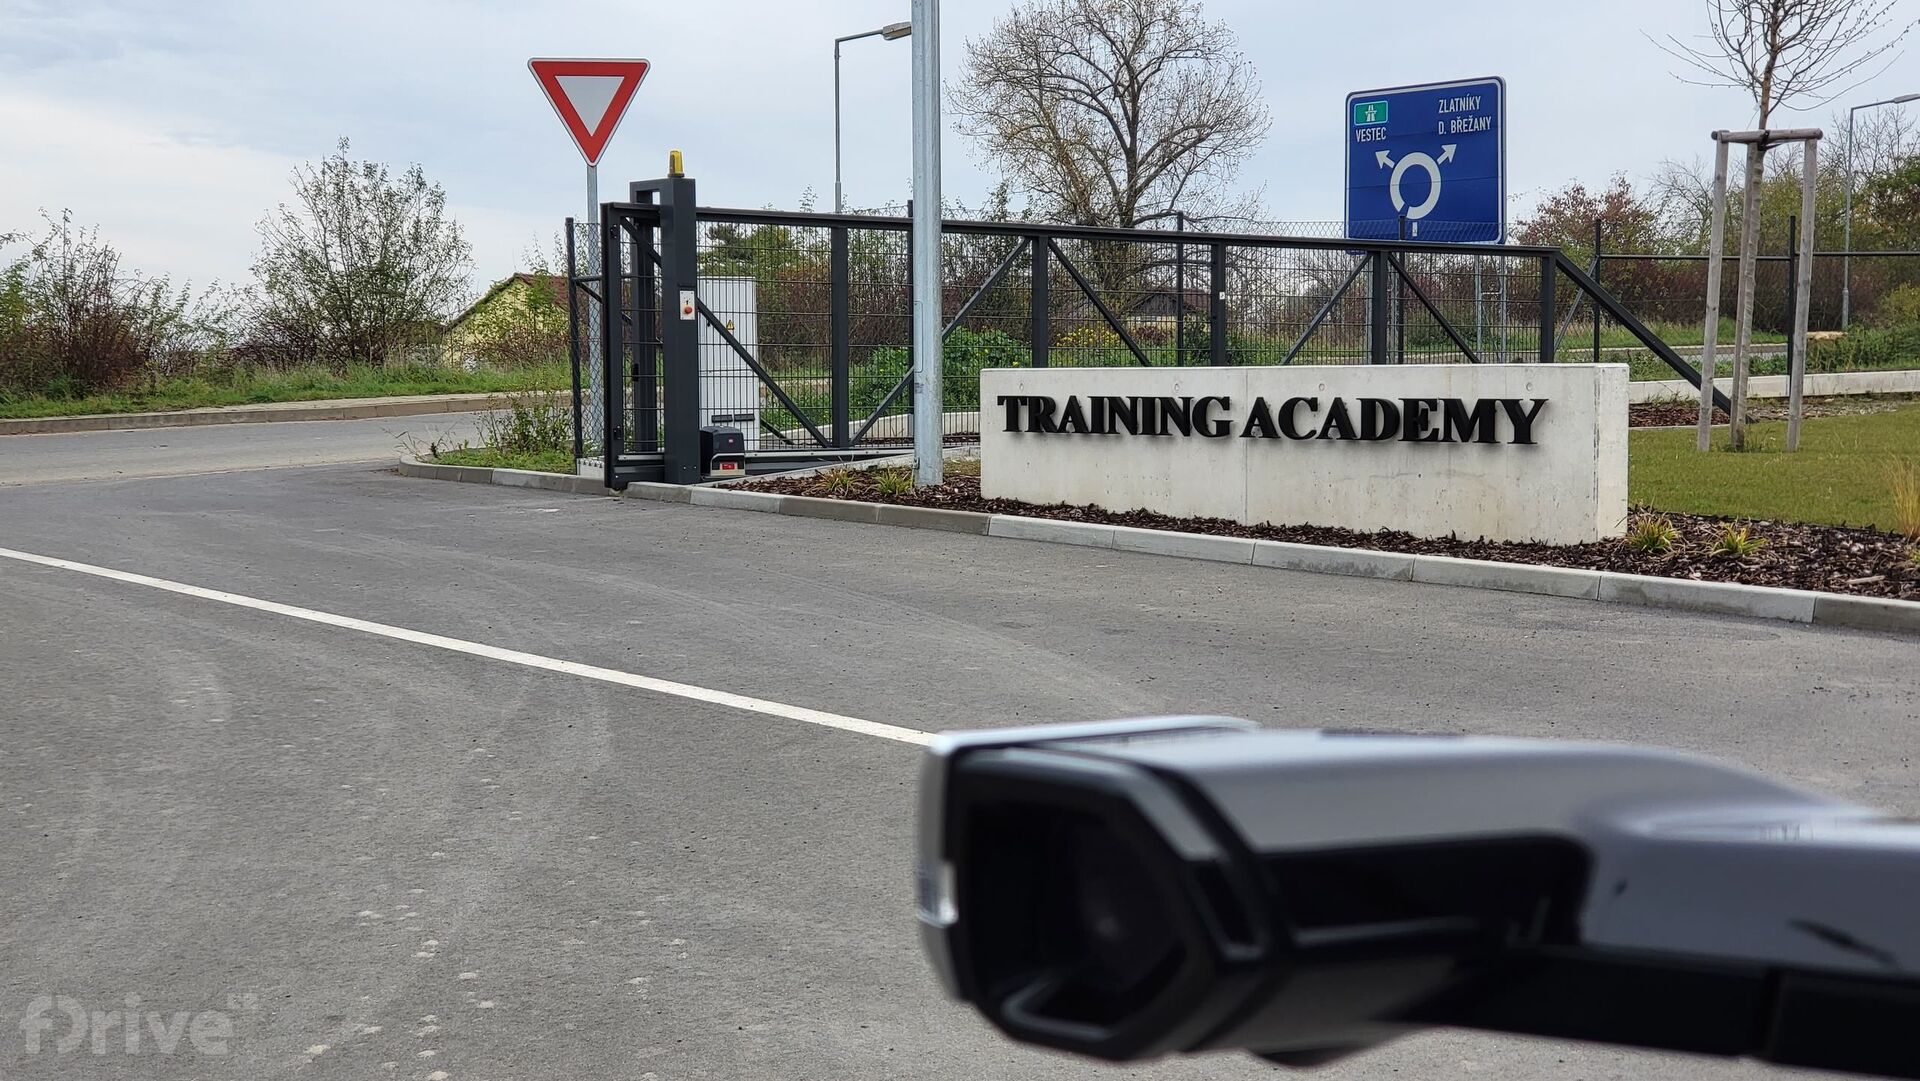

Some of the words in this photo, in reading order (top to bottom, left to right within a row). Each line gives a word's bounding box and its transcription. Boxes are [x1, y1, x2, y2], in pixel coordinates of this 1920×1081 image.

[1438, 93, 1481, 114] ZLATNÍKY
[1355, 126, 1387, 143] VESTEC
[1438, 121, 1447, 135] D.
[1450, 115, 1492, 133] BŘEŽANY
[996, 395, 1234, 438] TRAINING
[1239, 396, 1549, 445] ACADEMY
